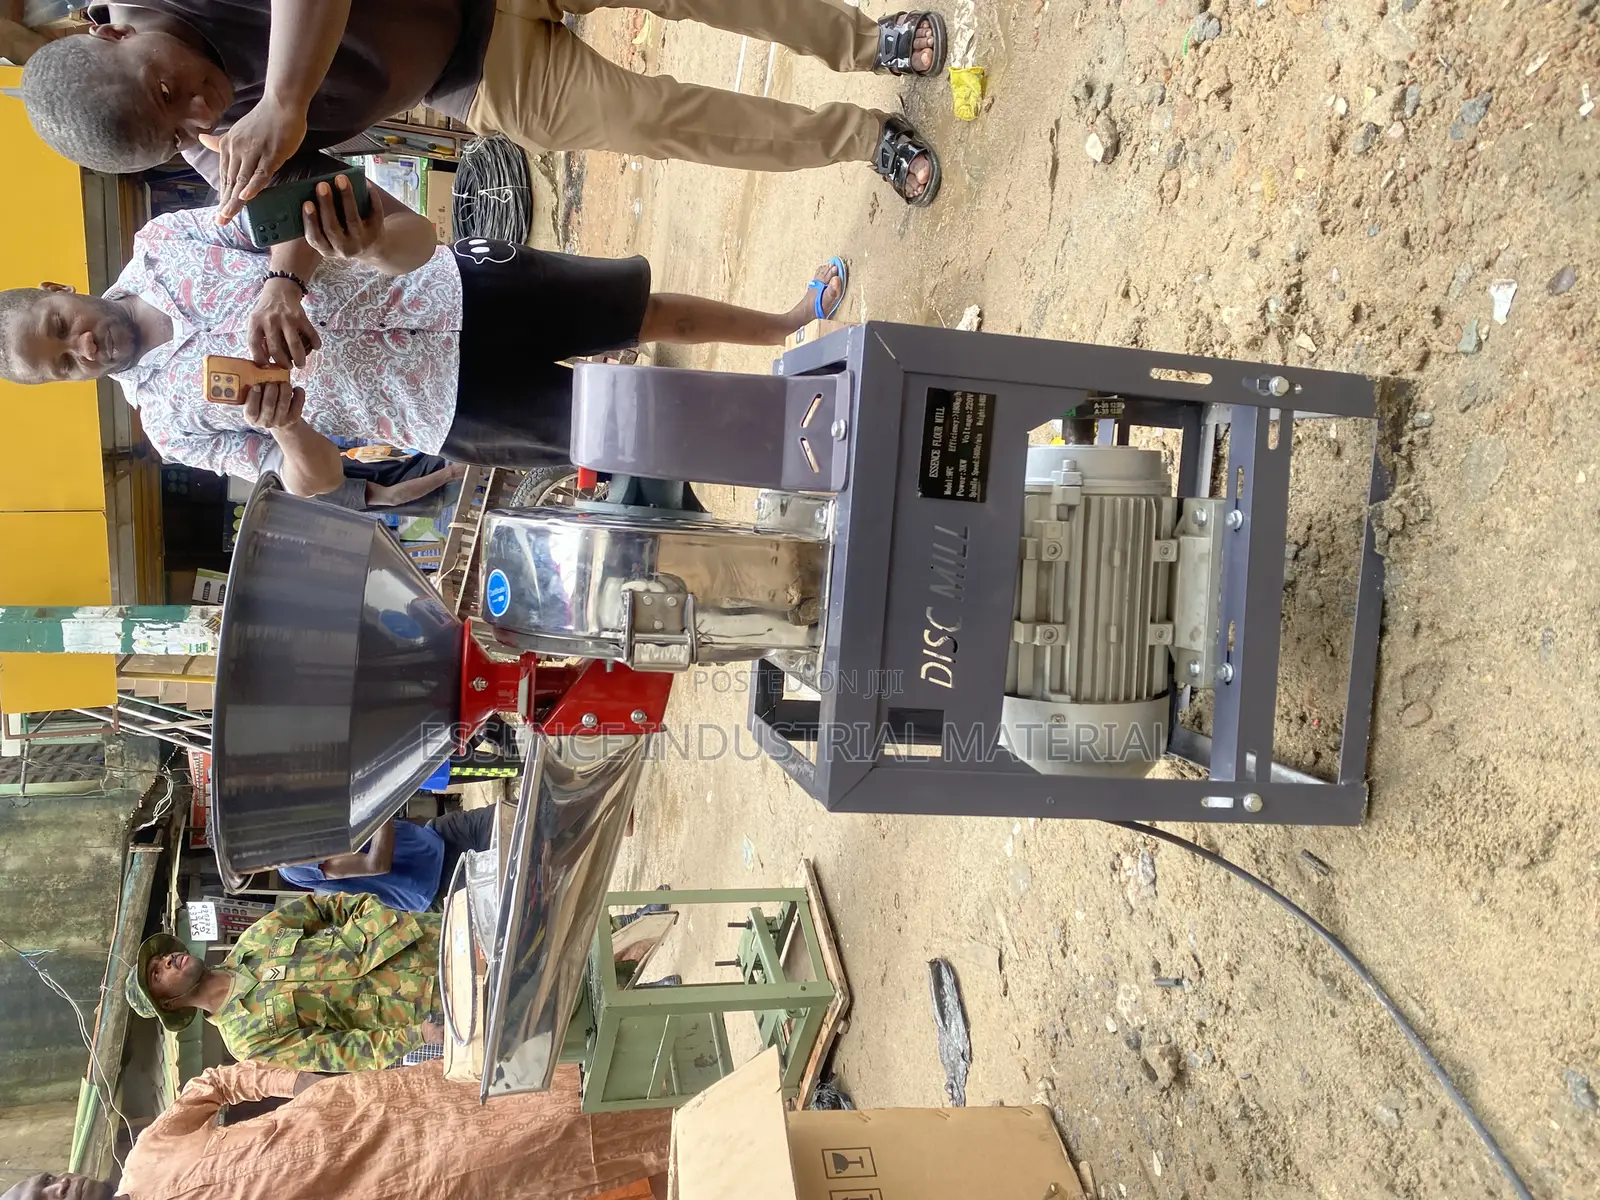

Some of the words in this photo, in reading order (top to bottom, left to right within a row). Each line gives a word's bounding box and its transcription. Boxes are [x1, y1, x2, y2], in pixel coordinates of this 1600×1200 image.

[934, 406, 946, 423] MILL
[932, 426, 944, 447] FLOUR
[929, 449, 941, 478] ESSENCE
[929, 525, 969, 602] MILL
[920, 606, 962, 689] DISC
[189, 905, 200, 937] SALES
[198, 909, 206, 933] GIRL
[202, 904, 211, 935] NEEDED
